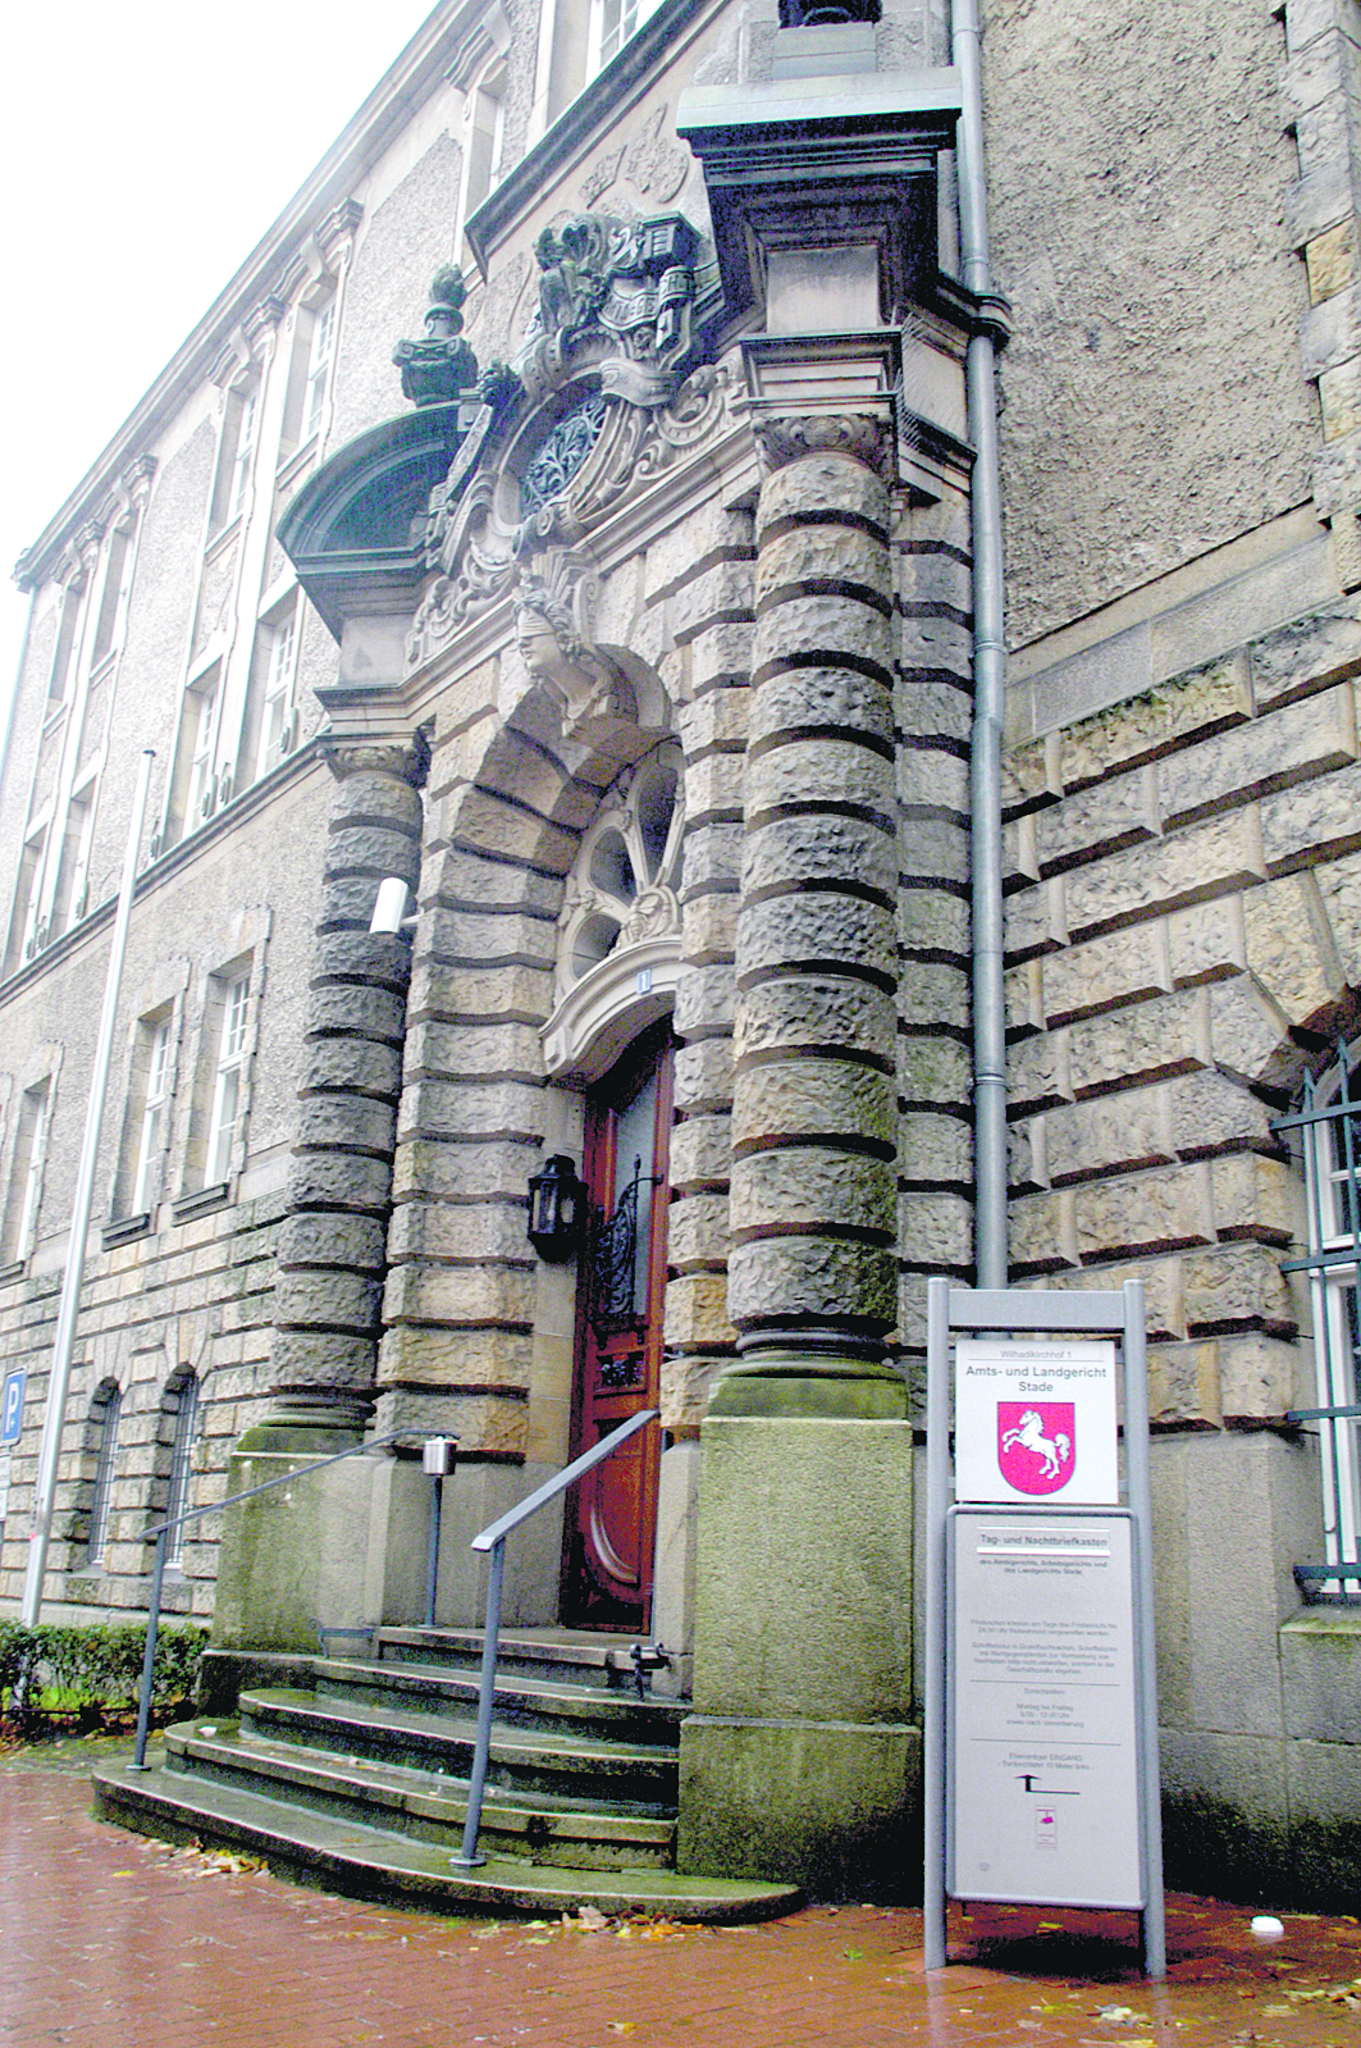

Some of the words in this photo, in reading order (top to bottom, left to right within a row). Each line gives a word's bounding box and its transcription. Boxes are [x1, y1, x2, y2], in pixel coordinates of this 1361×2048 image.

[641, 973, 647, 990] 1
[966, 1366, 1002, 1376] Amts-
[1006, 1366, 1029, 1377] und
[1033, 1367, 1107, 1380] Landgericht
[1018, 1381, 1054, 1392] Stade
[5, 1382, 20, 1433] P
[981, 1534, 1000, 1545] Tag-
[1004, 1535, 1022, 1544] und
[1025, 1536, 1107, 1546] Nachtbriefkasten
